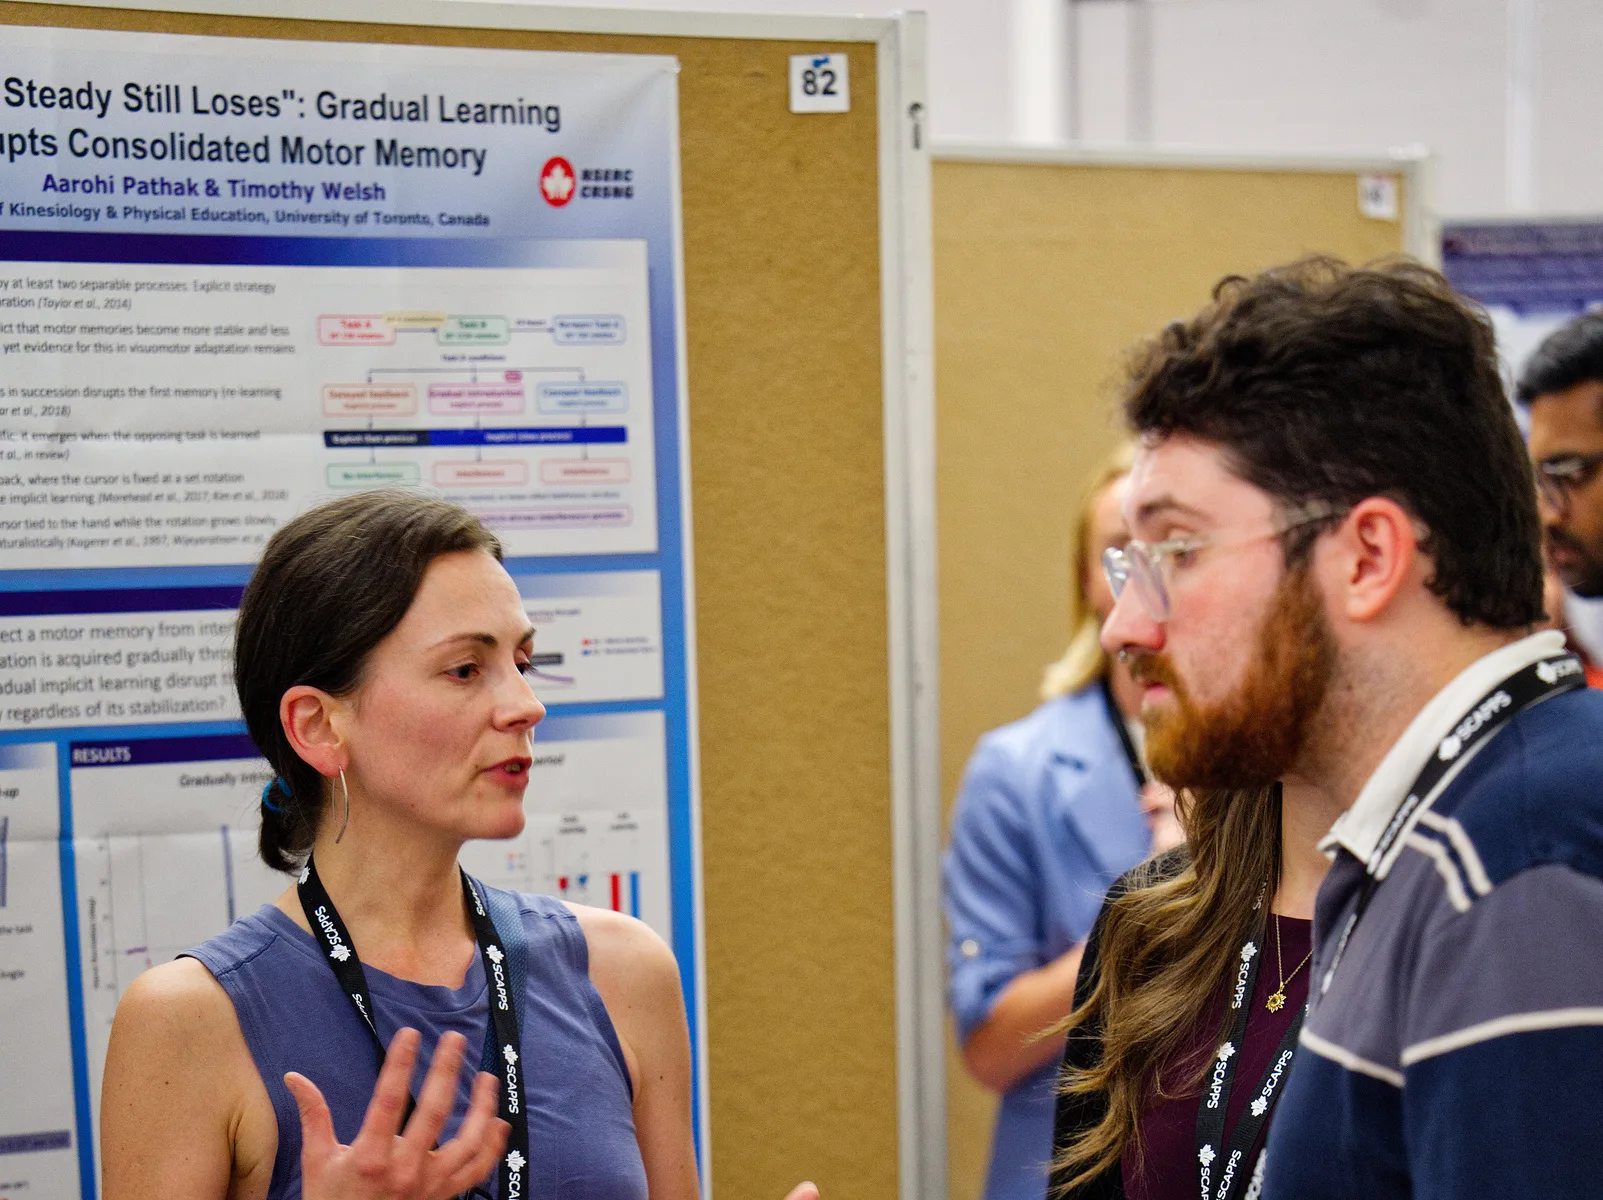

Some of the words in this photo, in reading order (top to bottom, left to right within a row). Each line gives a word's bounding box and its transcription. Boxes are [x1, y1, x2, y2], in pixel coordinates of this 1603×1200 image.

[802, 70, 837, 95] 82
[4, 77, 112, 118] Steady
[123, 83, 181, 114] Still
[192, 86, 305, 118] Loses":
[316, 90, 428, 122] Gradual
[439, 95, 561, 133] Learning
[0, 128, 58, 162] pts
[68, 128, 270, 163] Consolidated
[281, 136, 365, 166] Motor
[375, 139, 487, 175] Memory
[42, 173, 115, 195] Aarohi
[123, 177, 199, 197] Pathak
[205, 179, 220, 197] &
[227, 179, 314, 202] Timothy
[322, 182, 386, 201] Welsh
[10, 203, 101, 221] Kinesiology
[107, 206, 118, 219] &
[123, 206, 186, 222] Physical
[191, 208, 270, 224] Education,
[275, 209, 350, 227] University
[355, 211, 369, 224] of
[438, 213, 490, 227] Canada
[27, 630, 35, 641] a
[40, 627, 84, 640] motor
[91, 626, 153, 642] memory
[159, 622, 195, 637] from
[41, 653, 53, 666] is
[57, 651, 122, 668] acquired
[127, 649, 193, 667] gradually
[40, 678, 93, 693] implicit
[101, 676, 161, 692] learning
[166, 673, 217, 688] disrupt
[8, 704, 81, 723] regardless
[86, 701, 101, 715] of
[107, 701, 125, 715] its
[129, 697, 225, 714] stabilization?
[73, 747, 131, 763] RESULTS
[314, 905, 342, 946] SCAPPS
[491, 963, 508, 1011] SCAPPS
[1231, 962, 1250, 1009] SCAPPS
[506, 1063, 519, 1114] SCAPPS
[1207, 1060, 1227, 1109] SCAPPS
[1262, 1049, 1293, 1098] SCAPPS
[1217, 1149, 1242, 1200] SCAPPS
